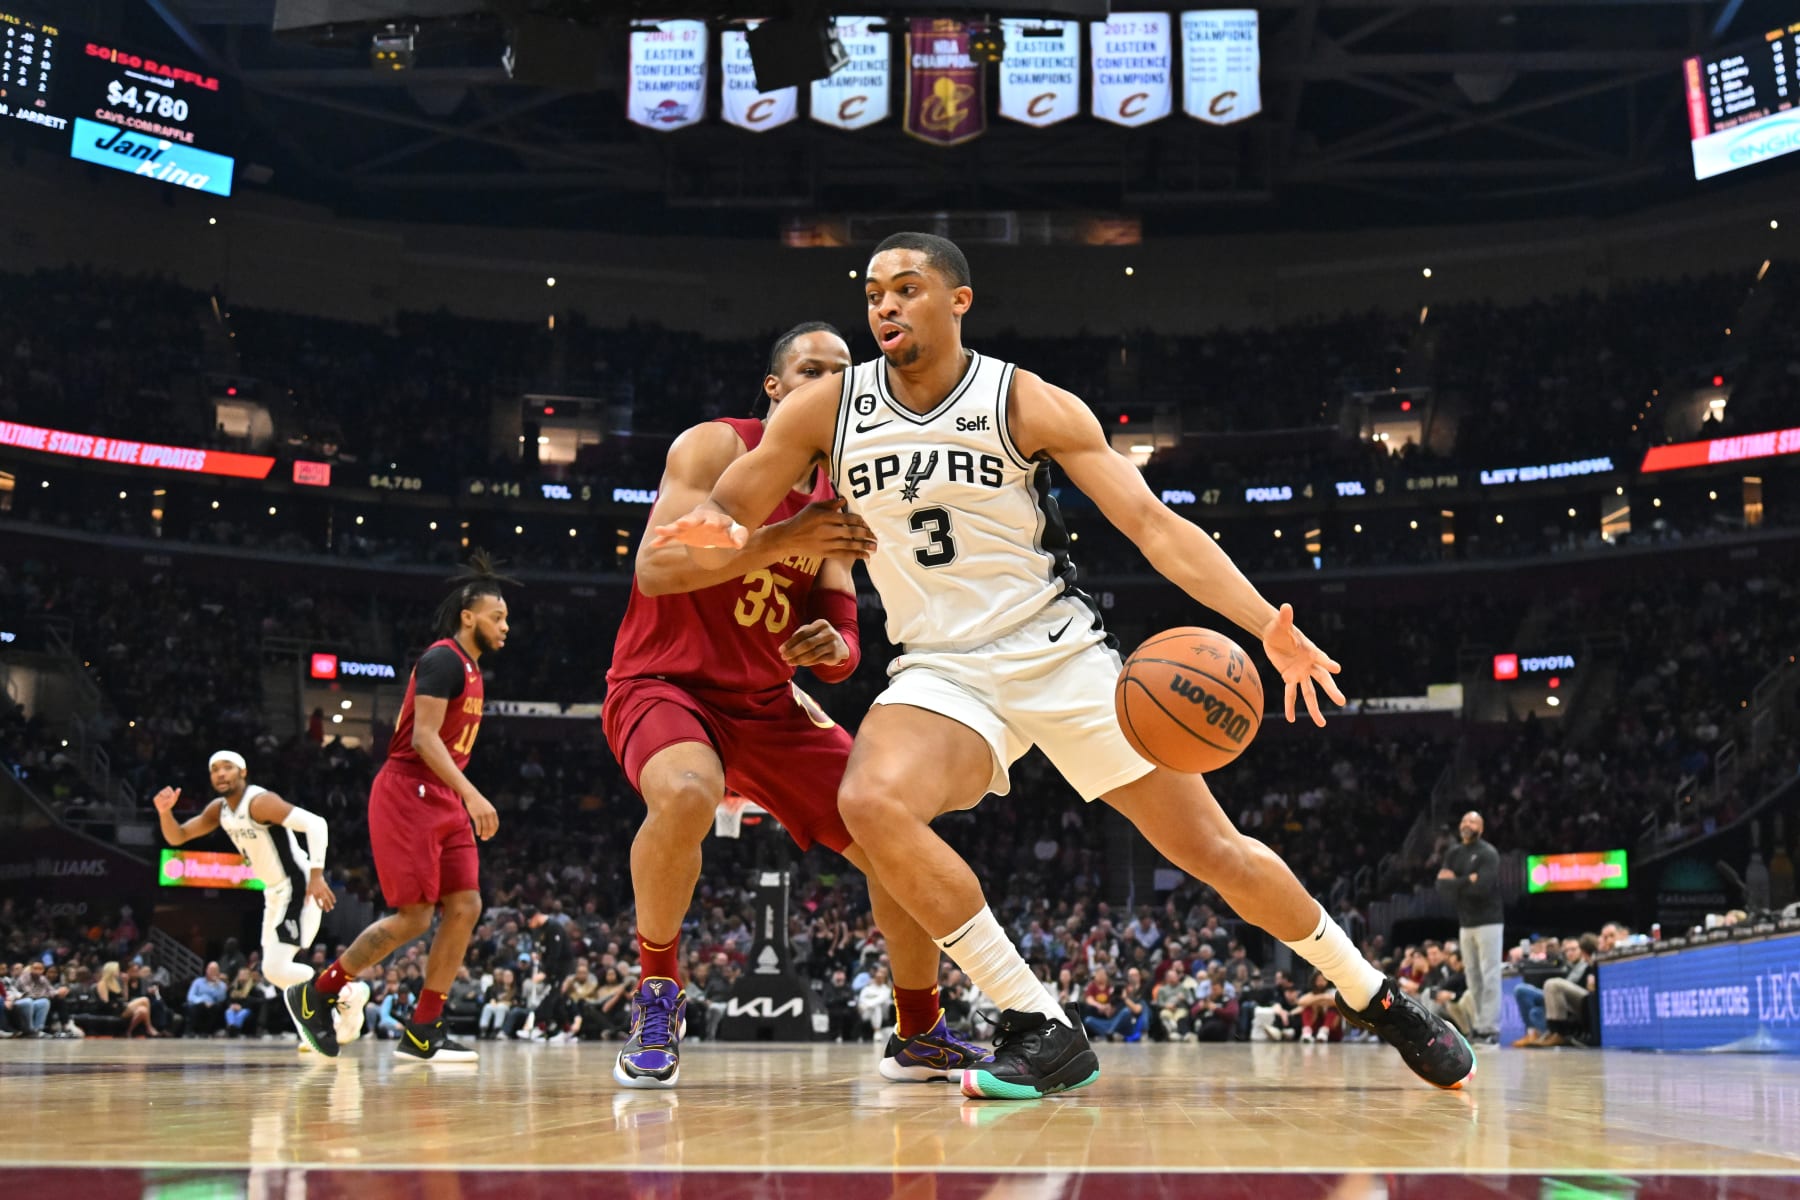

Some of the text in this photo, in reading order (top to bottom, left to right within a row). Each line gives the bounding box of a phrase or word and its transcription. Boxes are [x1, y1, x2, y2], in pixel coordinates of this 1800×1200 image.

[1188, 30, 1253, 41] CHAMPIONS
[645, 48, 695, 61] EASTERN
[1016, 41, 1065, 53] EASTERN
[1106, 41, 1157, 53] EASTERN
[635, 64, 705, 76] CONFERENCE
[1006, 57, 1076, 68] CONFERENCE
[1097, 56, 1168, 68] CONFERENCE
[144, 60, 219, 91] RAFFLE
[1009, 73, 1073, 85] CHAMPIONS
[1099, 73, 1164, 85] CHAMPIONS
[637, 80, 701, 92] CHAMPIONS
[106, 80, 189, 121] $4,780
[95, 129, 172, 161] Jani
[859, 395, 874, 414] 6
[956, 416, 990, 432] Self.
[48, 430, 95, 458] STATS
[94, 437, 107, 459] &
[107, 439, 141, 463] LIVE
[140, 443, 206, 471] UPDATES
[1709, 431, 1777, 463] REALTIME
[848, 450, 1004, 504] SPURS
[1480, 470, 1518, 485] LET
[1245, 486, 1293, 503] FOULS
[1335, 481, 1366, 497] TOL
[908, 505, 958, 570] 3
[734, 568, 794, 634] 35
[340, 660, 396, 678] TOYOTA
[1521, 655, 1575, 671] TOYOTA
[1170, 673, 1250, 744] Wilson
[1671, 988, 1698, 1018] MAKE
[1699, 985, 1750, 1017] DOCTORS
